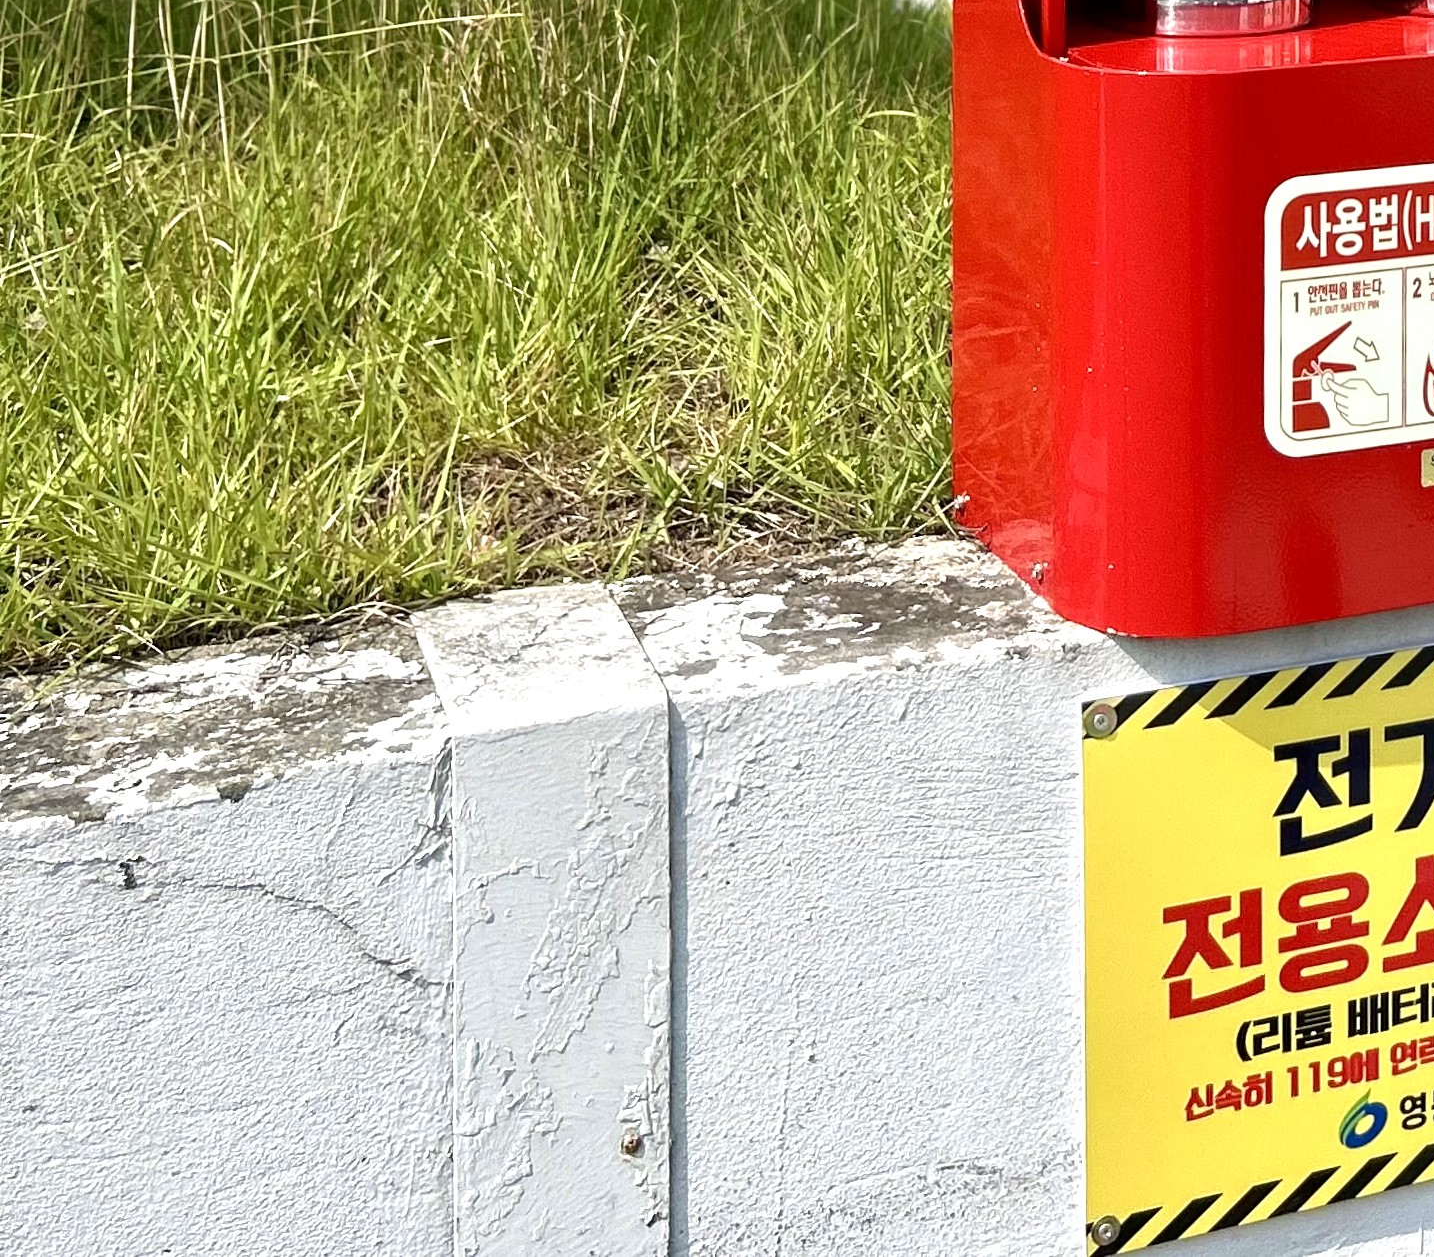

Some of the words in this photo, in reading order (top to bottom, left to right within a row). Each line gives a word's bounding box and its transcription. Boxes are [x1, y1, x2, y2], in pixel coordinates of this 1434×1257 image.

[1307, 282, 1348, 304] 안전핀을
[1352, 278, 1386, 299] 뽑는다.
[1412, 277, 1422, 299] 2
[1293, 291, 1300, 313] 1
[1310, 305, 1323, 317] PUT
[1341, 301, 1366, 314] SAFETY
[1236, 1002, 1333, 1061] (리튬
[1185, 1070, 1274, 1122] 신속히
[1286, 1046, 1380, 1096] 119에
